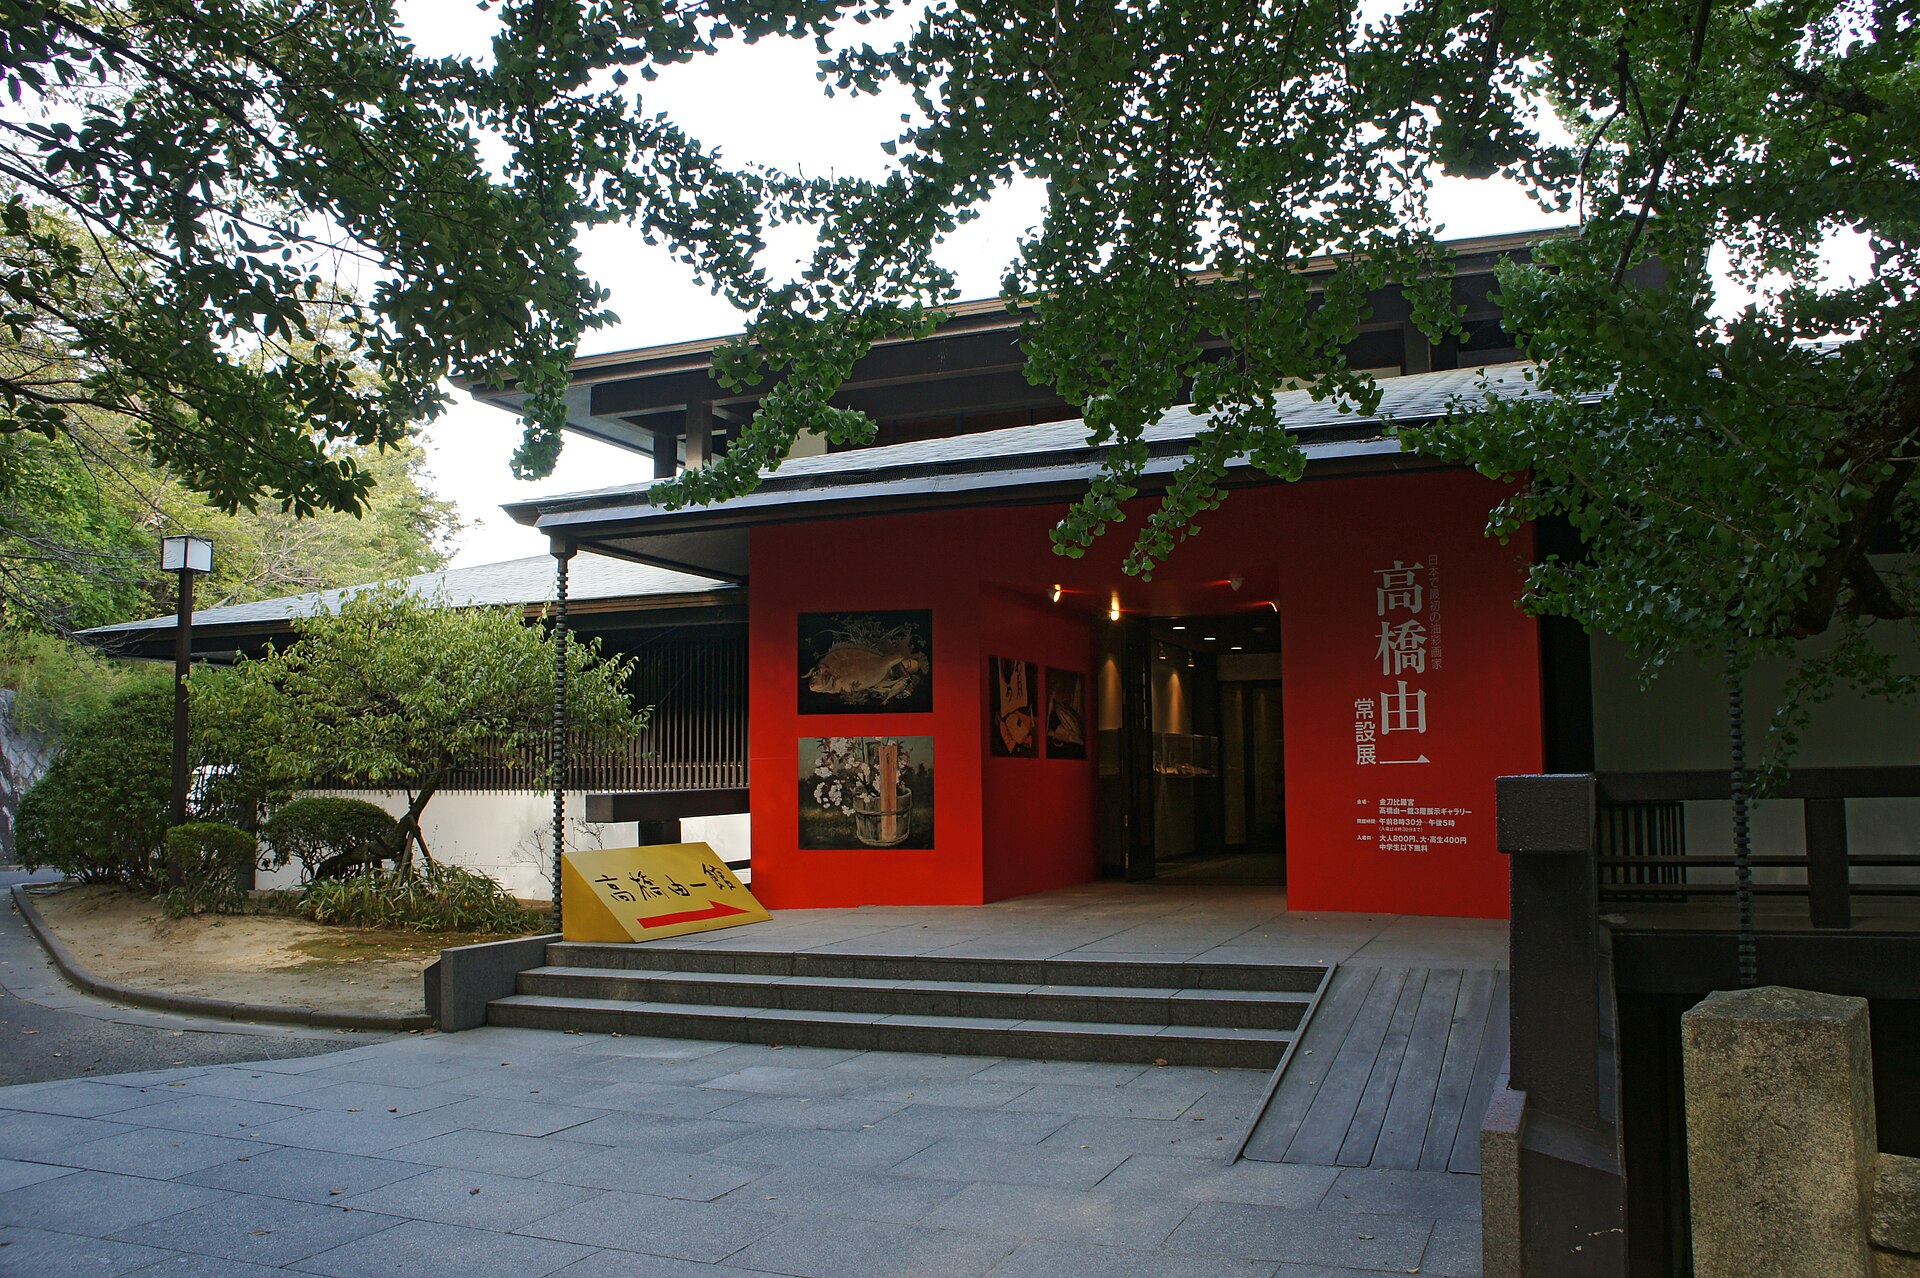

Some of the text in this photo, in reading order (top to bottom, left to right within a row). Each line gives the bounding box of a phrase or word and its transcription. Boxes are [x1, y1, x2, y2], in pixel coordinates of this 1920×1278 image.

[1428, 554, 1443, 670] 日本で最初の油彩画家
[1372, 560, 1431, 766] 高橋由一
[1354, 697, 1377, 766] 常設展
[1379, 843, 1428, 852] 中学生以下無料
